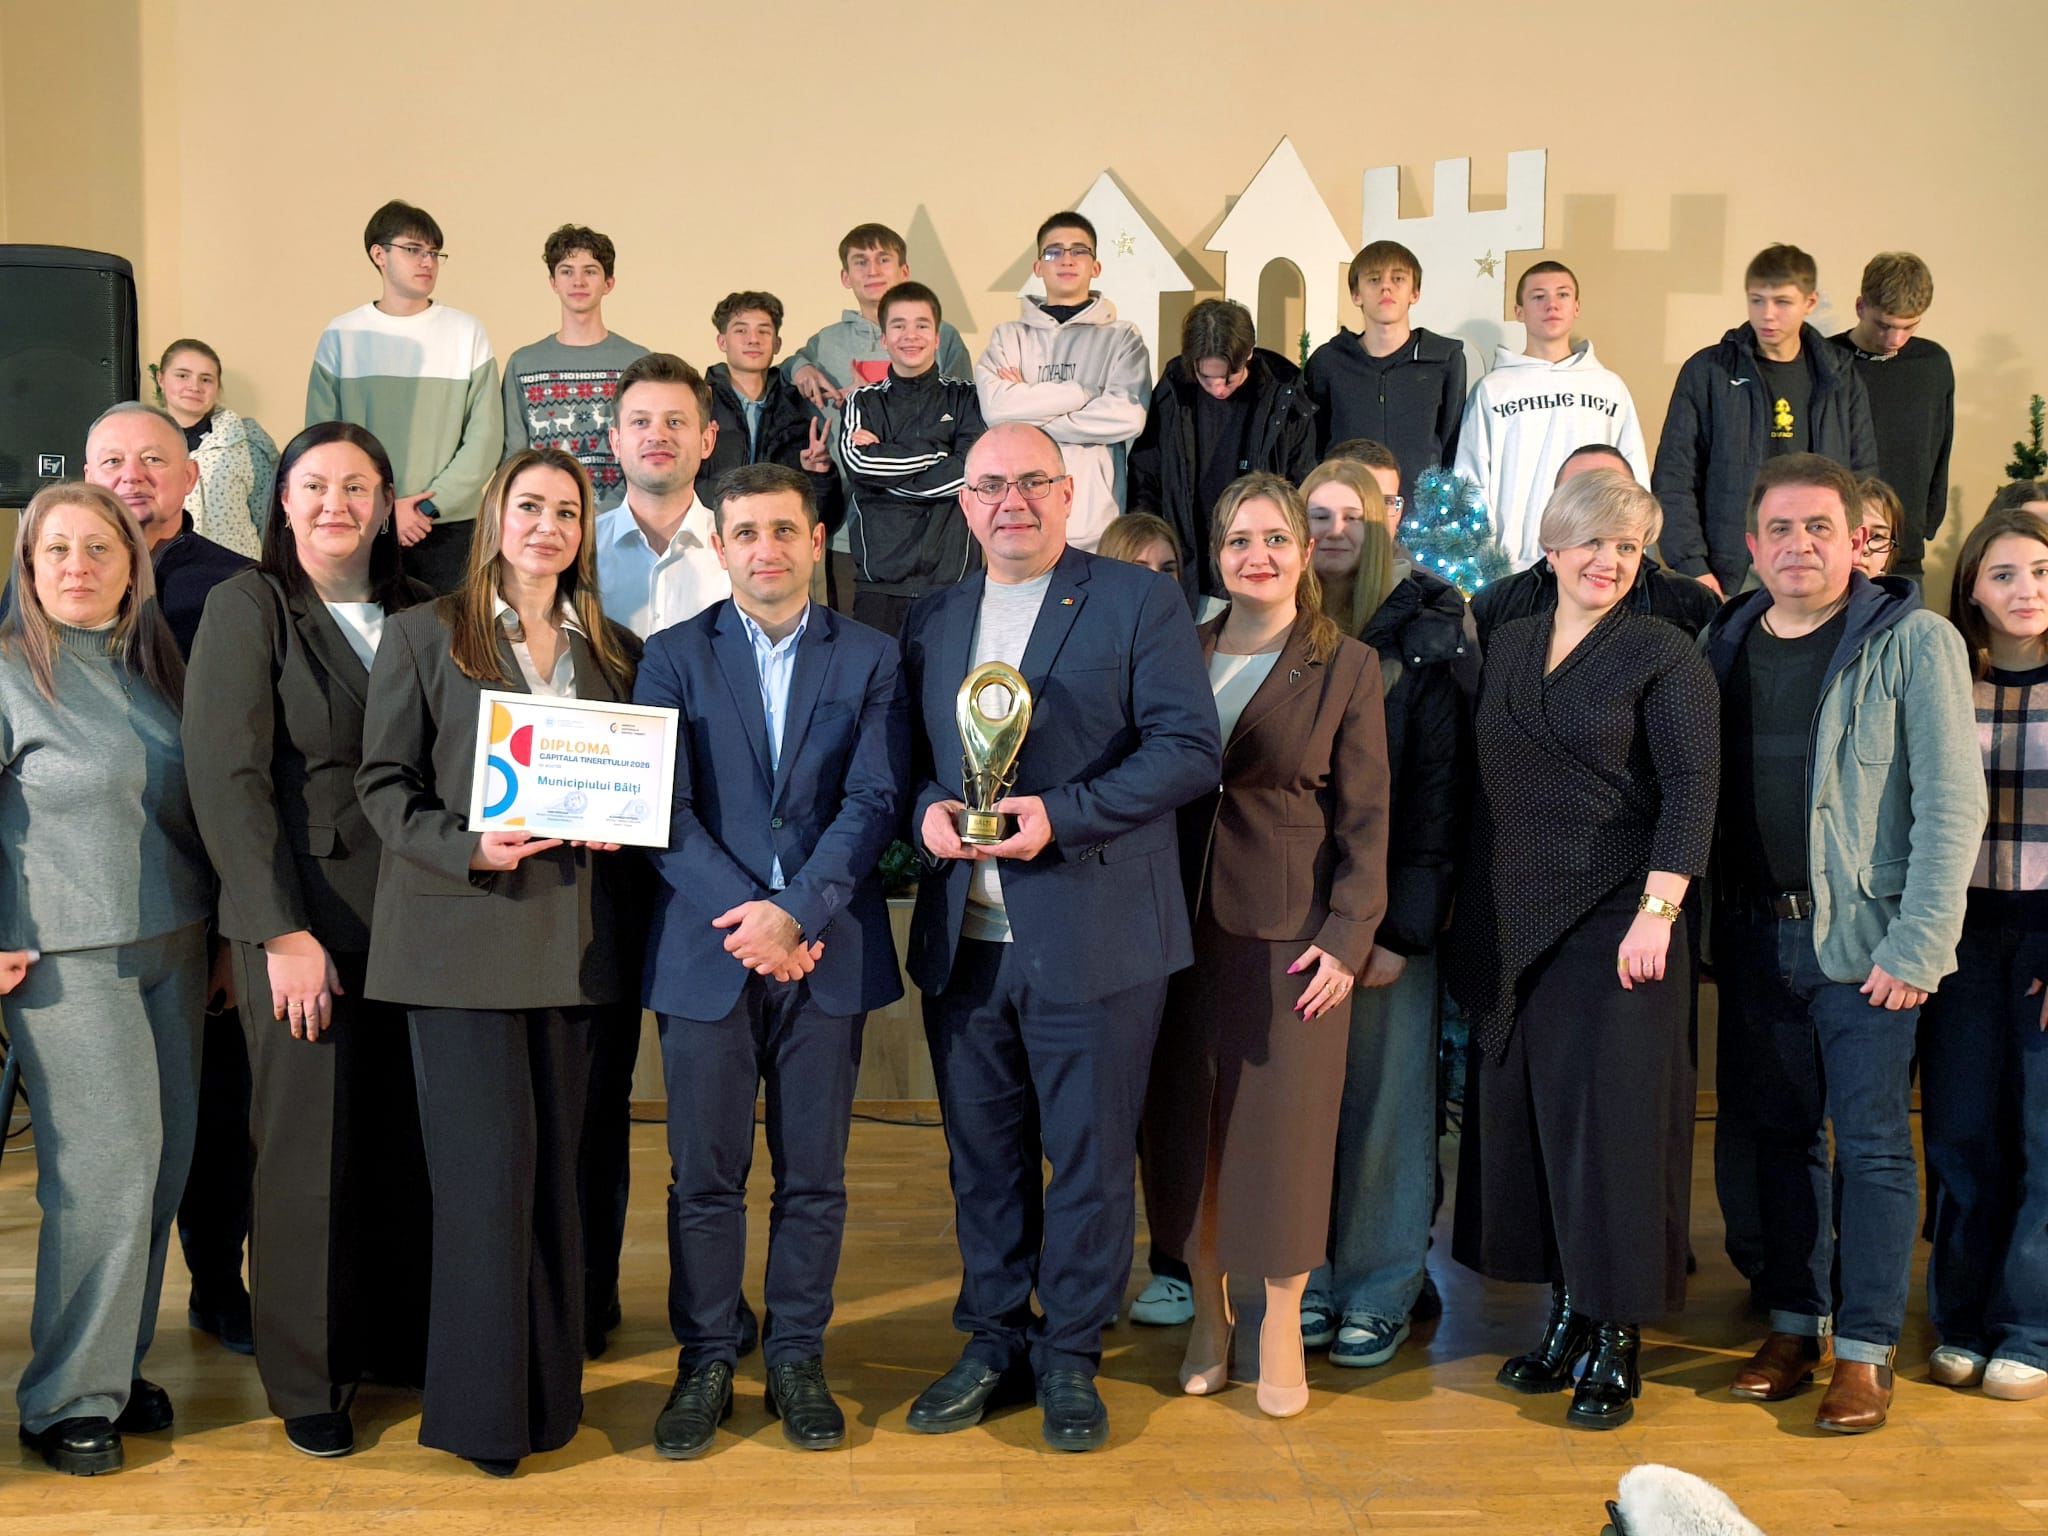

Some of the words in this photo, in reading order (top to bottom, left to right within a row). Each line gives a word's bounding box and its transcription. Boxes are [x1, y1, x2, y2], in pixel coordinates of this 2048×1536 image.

[520, 373, 550, 384] HOHO
[1492, 392, 1575, 418] ЧЕРНЫЕ
[42, 458, 61, 474] EV
[540, 738, 611, 756] DIPLOMA
[539, 752, 579, 763] CAPITALA
[580, 756, 629, 767] TINERETULUI
[630, 760, 650, 769] 2026
[537, 775, 611, 791] Municipiului
